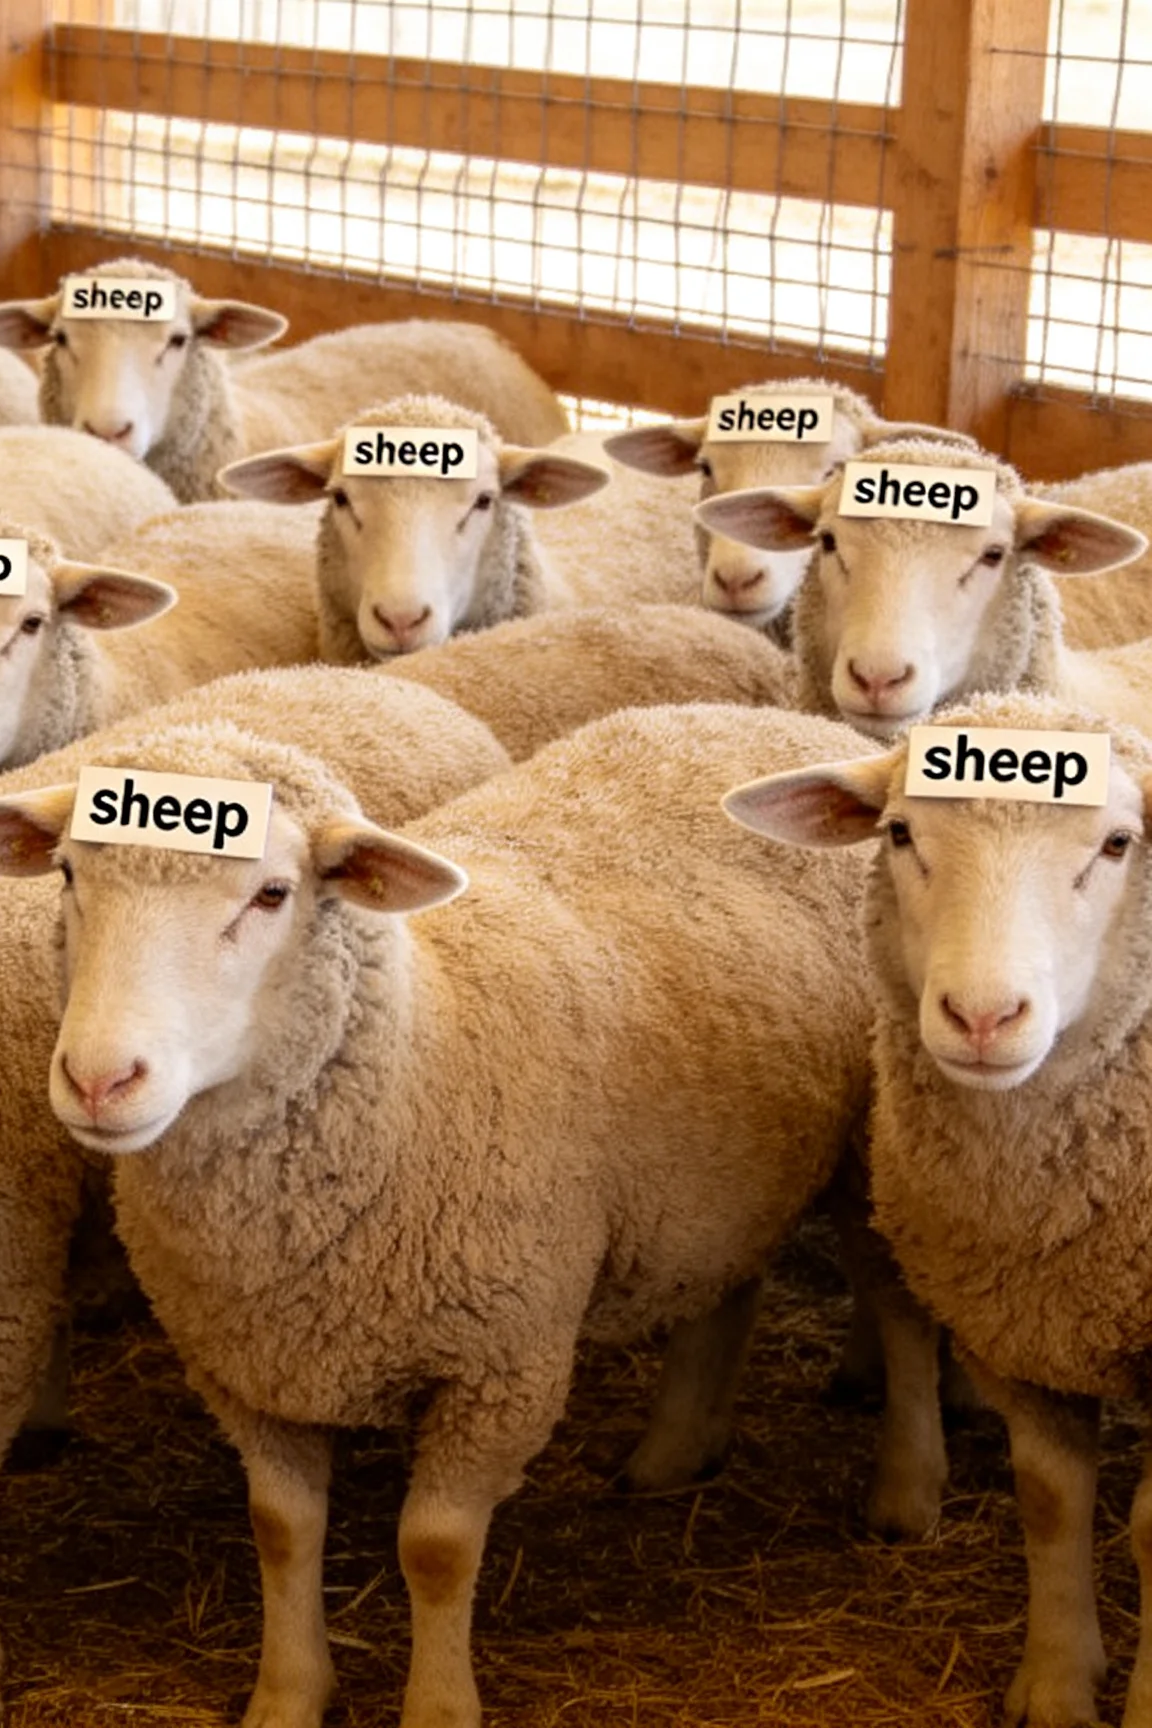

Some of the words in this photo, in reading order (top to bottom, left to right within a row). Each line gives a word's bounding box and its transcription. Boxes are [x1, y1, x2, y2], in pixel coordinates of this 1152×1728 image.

[73, 282, 163, 317] sheep
[718, 400, 819, 440] sheep
[355, 432, 464, 475] sheep
[854, 469, 979, 520] sheep
[922, 734, 1088, 799] sheep
[89, 778, 249, 850] sheep
